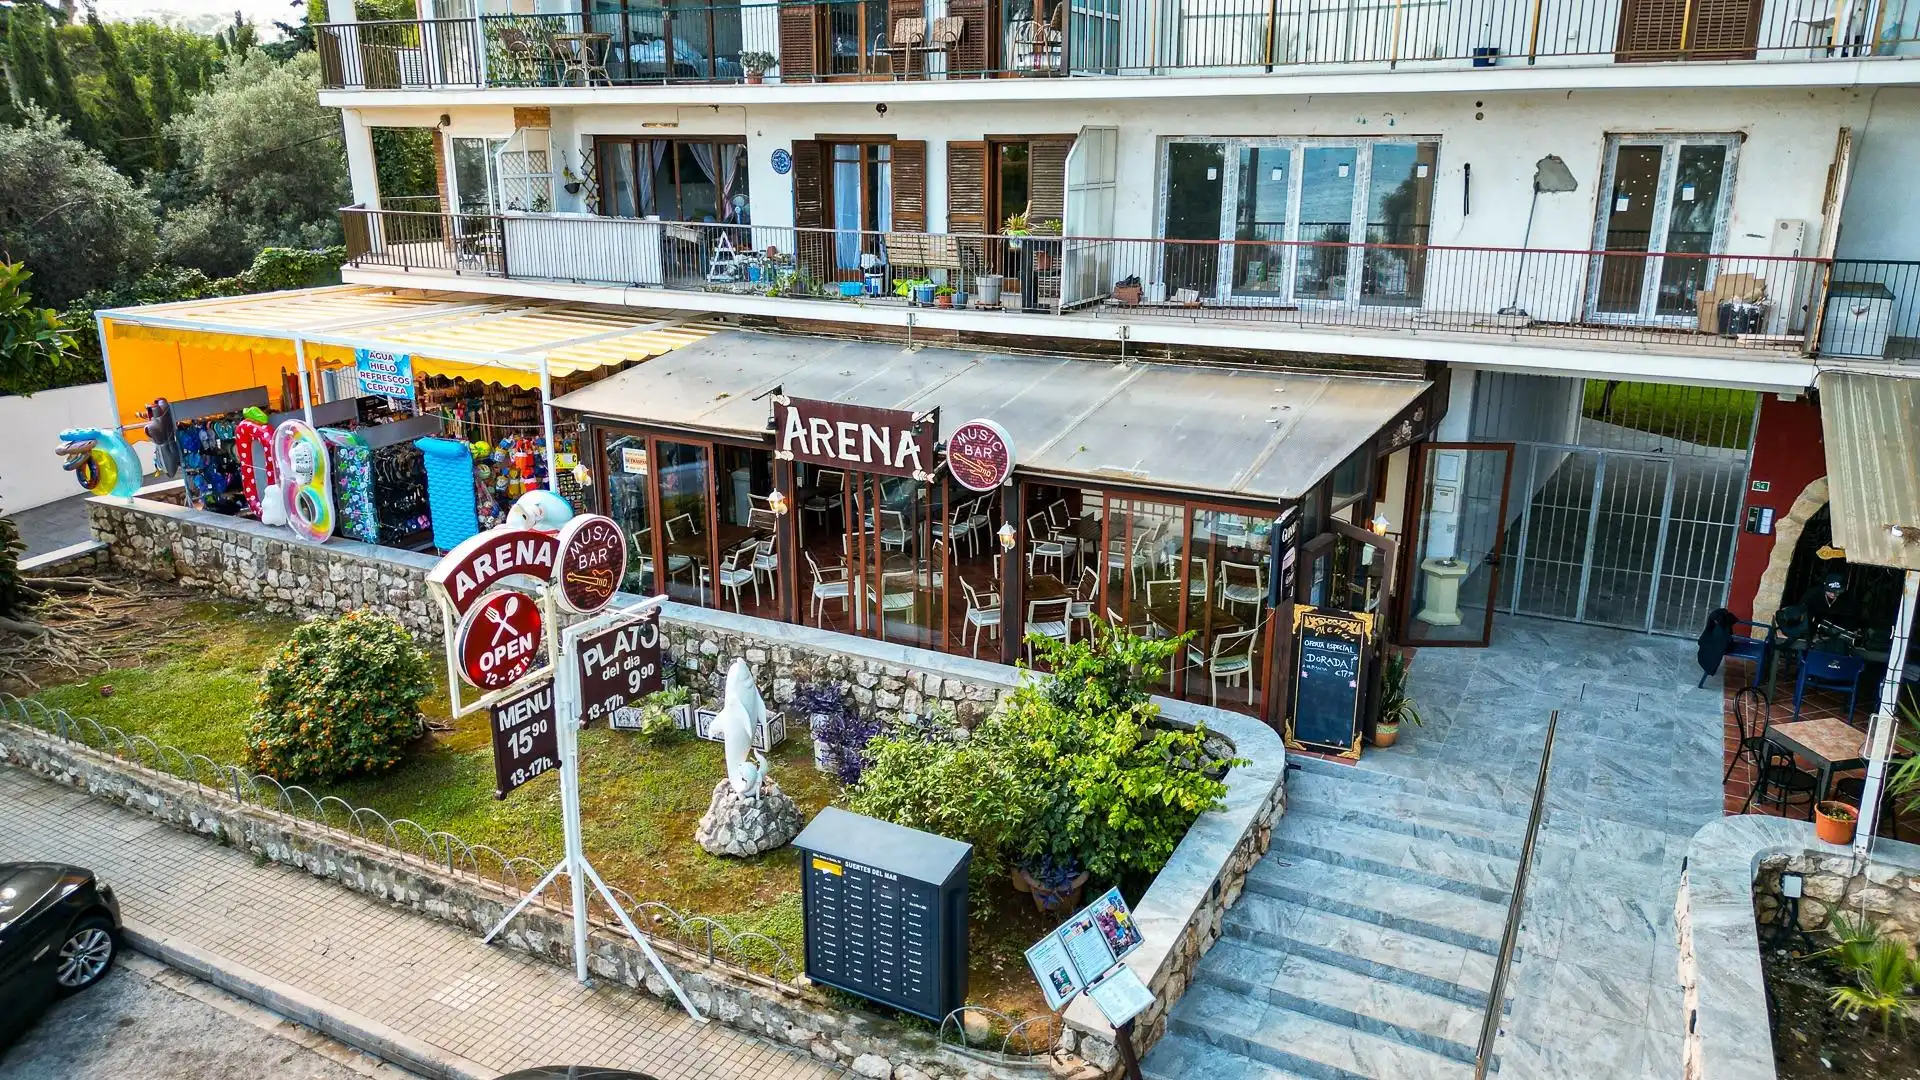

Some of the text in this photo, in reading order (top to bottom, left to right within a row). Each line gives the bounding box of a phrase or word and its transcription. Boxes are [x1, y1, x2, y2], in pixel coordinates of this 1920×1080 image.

[369, 352, 395, 361] AGUA
[370, 362, 397, 372] HIELO
[360, 371, 410, 385] REFRESCOS
[366, 382, 406, 395] CERVEZA
[782, 406, 922, 471] ARENA
[957, 428, 1003, 452] MUSIC
[964, 444, 992, 459] BAR
[570, 525, 618, 560] MUSIC
[578, 547, 607, 570] BAR
[455, 539, 552, 602] ARENA
[479, 632, 533, 672] OPEN
[582, 623, 659, 677] PLATO
[1304, 640, 1355, 653] OFERTA ESPECIAL
[602, 662, 620, 680] del
[498, 687, 551, 732] MENU
[844, 861, 898, 881] SUERTES DEL MAR
